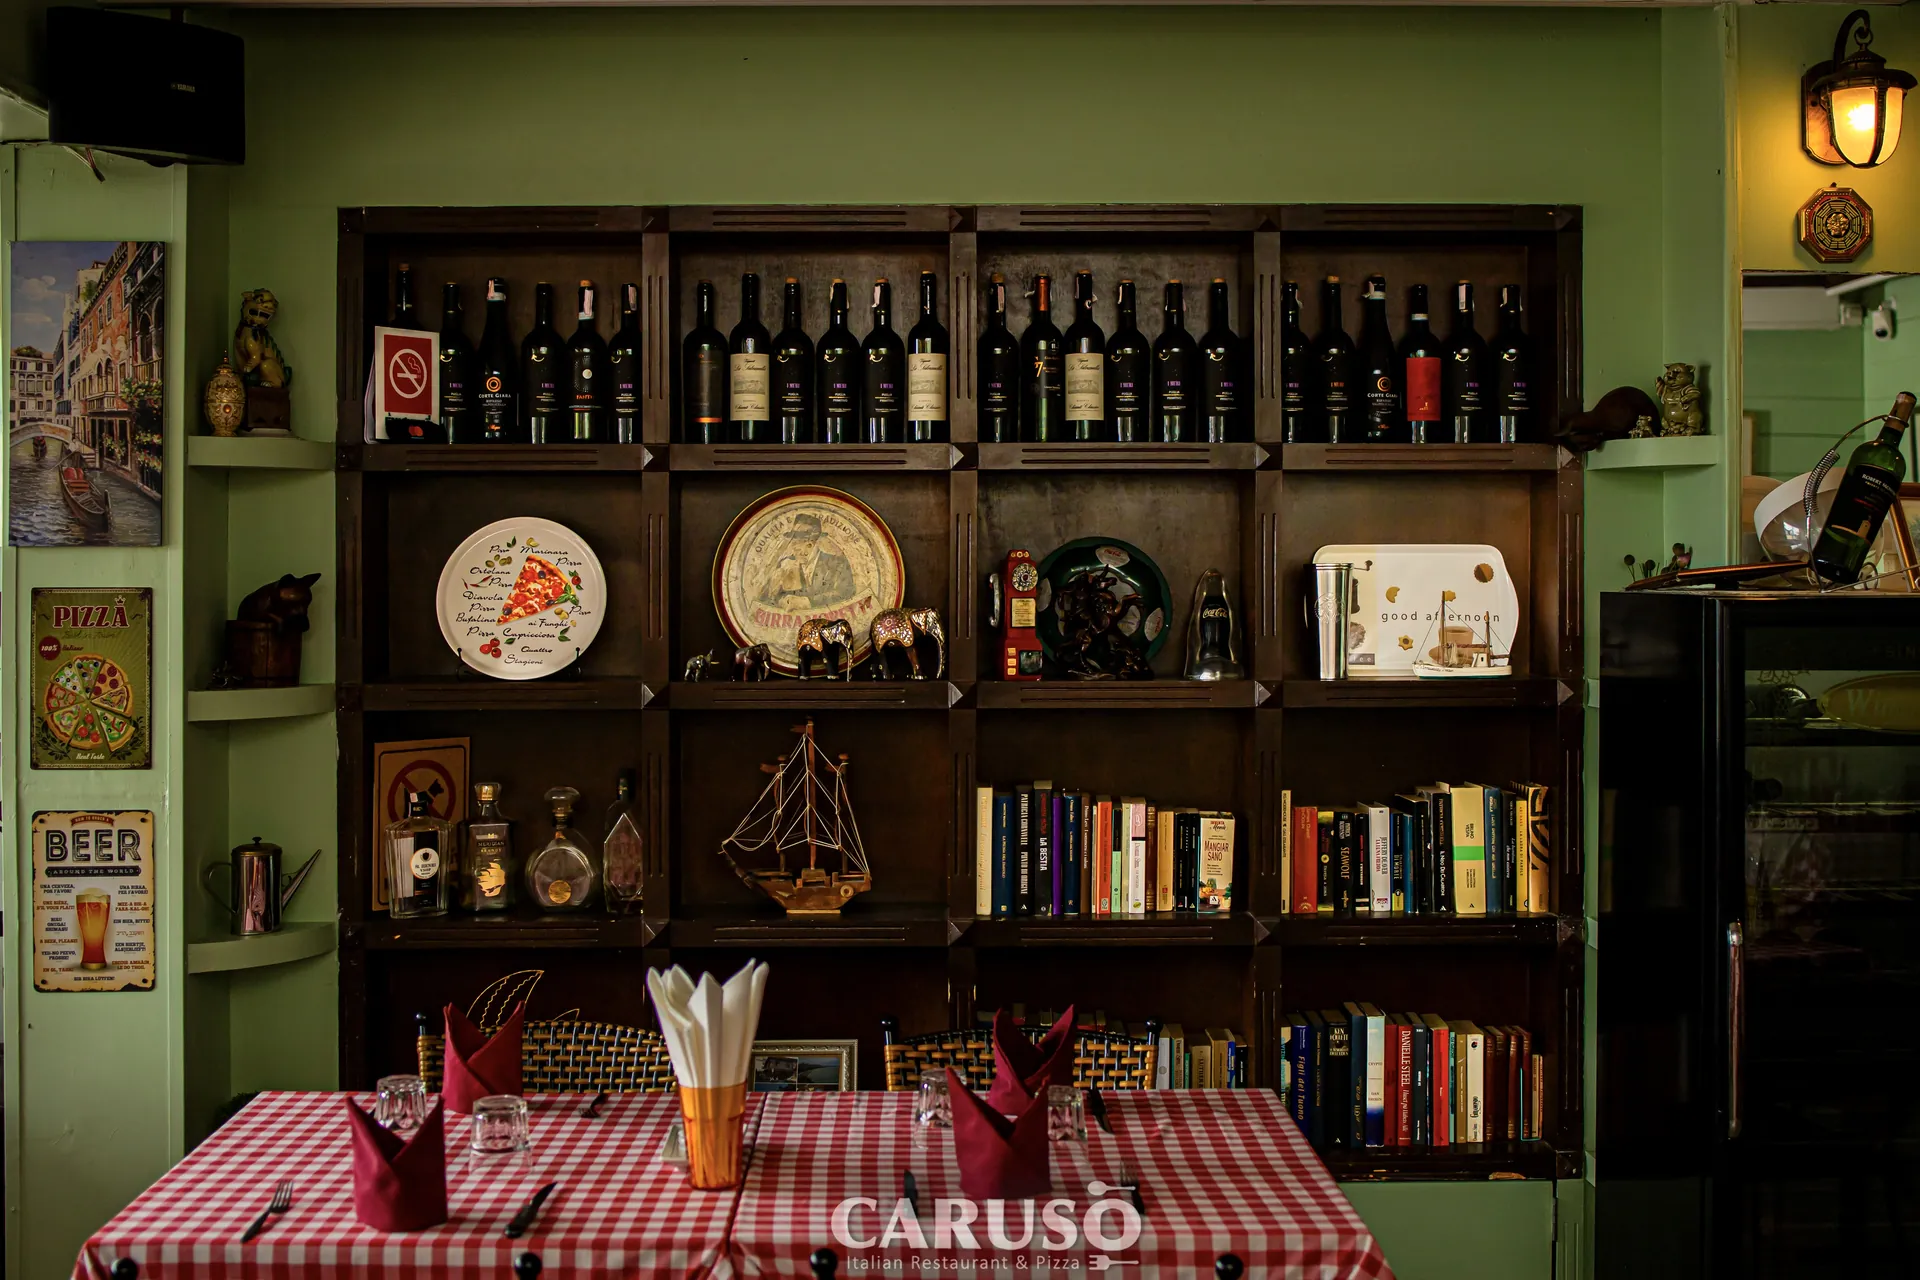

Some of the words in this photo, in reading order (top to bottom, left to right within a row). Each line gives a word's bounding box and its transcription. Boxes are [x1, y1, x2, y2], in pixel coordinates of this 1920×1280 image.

[1862, 474, 1882, 486] ROBERT
[814, 513, 860, 544] TRADIZIONE
[489, 545, 510, 553] Pizza
[520, 546, 568, 556] Marinara
[556, 557, 583, 566] Pizza
[470, 566, 511, 575] Ortolana
[488, 578, 513, 588] Pizza
[463, 591, 504, 601] Diavola
[469, 603, 496, 612] Pizza
[569, 606, 592, 615] Pizza
[52, 604, 129, 629] PIZZA
[456, 613, 496, 623] Bufalina
[755, 608, 803, 628] BIRRA
[1381, 611, 1418, 622] good
[538, 618, 568, 628] Funghi
[467, 627, 495, 637] Pizza
[502, 628, 556, 640] Capricciosa
[41, 644, 58, 652] 100%
[521, 646, 553, 654] Quattro
[504, 654, 543, 665] Stagioni
[1020, 793, 1028, 818] PATRICIA
[1020, 818, 1028, 846] CORNWELL
[45, 829, 142, 862] BEER
[1039, 837, 1047, 847] LA
[1204, 840, 1229, 852] MANGIAR
[1380, 836, 1388, 856] JEFFERY
[1020, 851, 1028, 868] PUNTO
[1039, 847, 1047, 871] BESTIA
[1207, 851, 1223, 861] SANO
[1340, 846, 1350, 880] SEAWOLF
[1020, 874, 1028, 894] ORIGINE
[1401, 1030, 1410, 1064] DANIELLE
[1297, 1056, 1306, 1075] Figli
[1401, 1065, 1410, 1087] STEEL
[1298, 1078, 1306, 1092] del
[1298, 1094, 1306, 1120] Tuono
